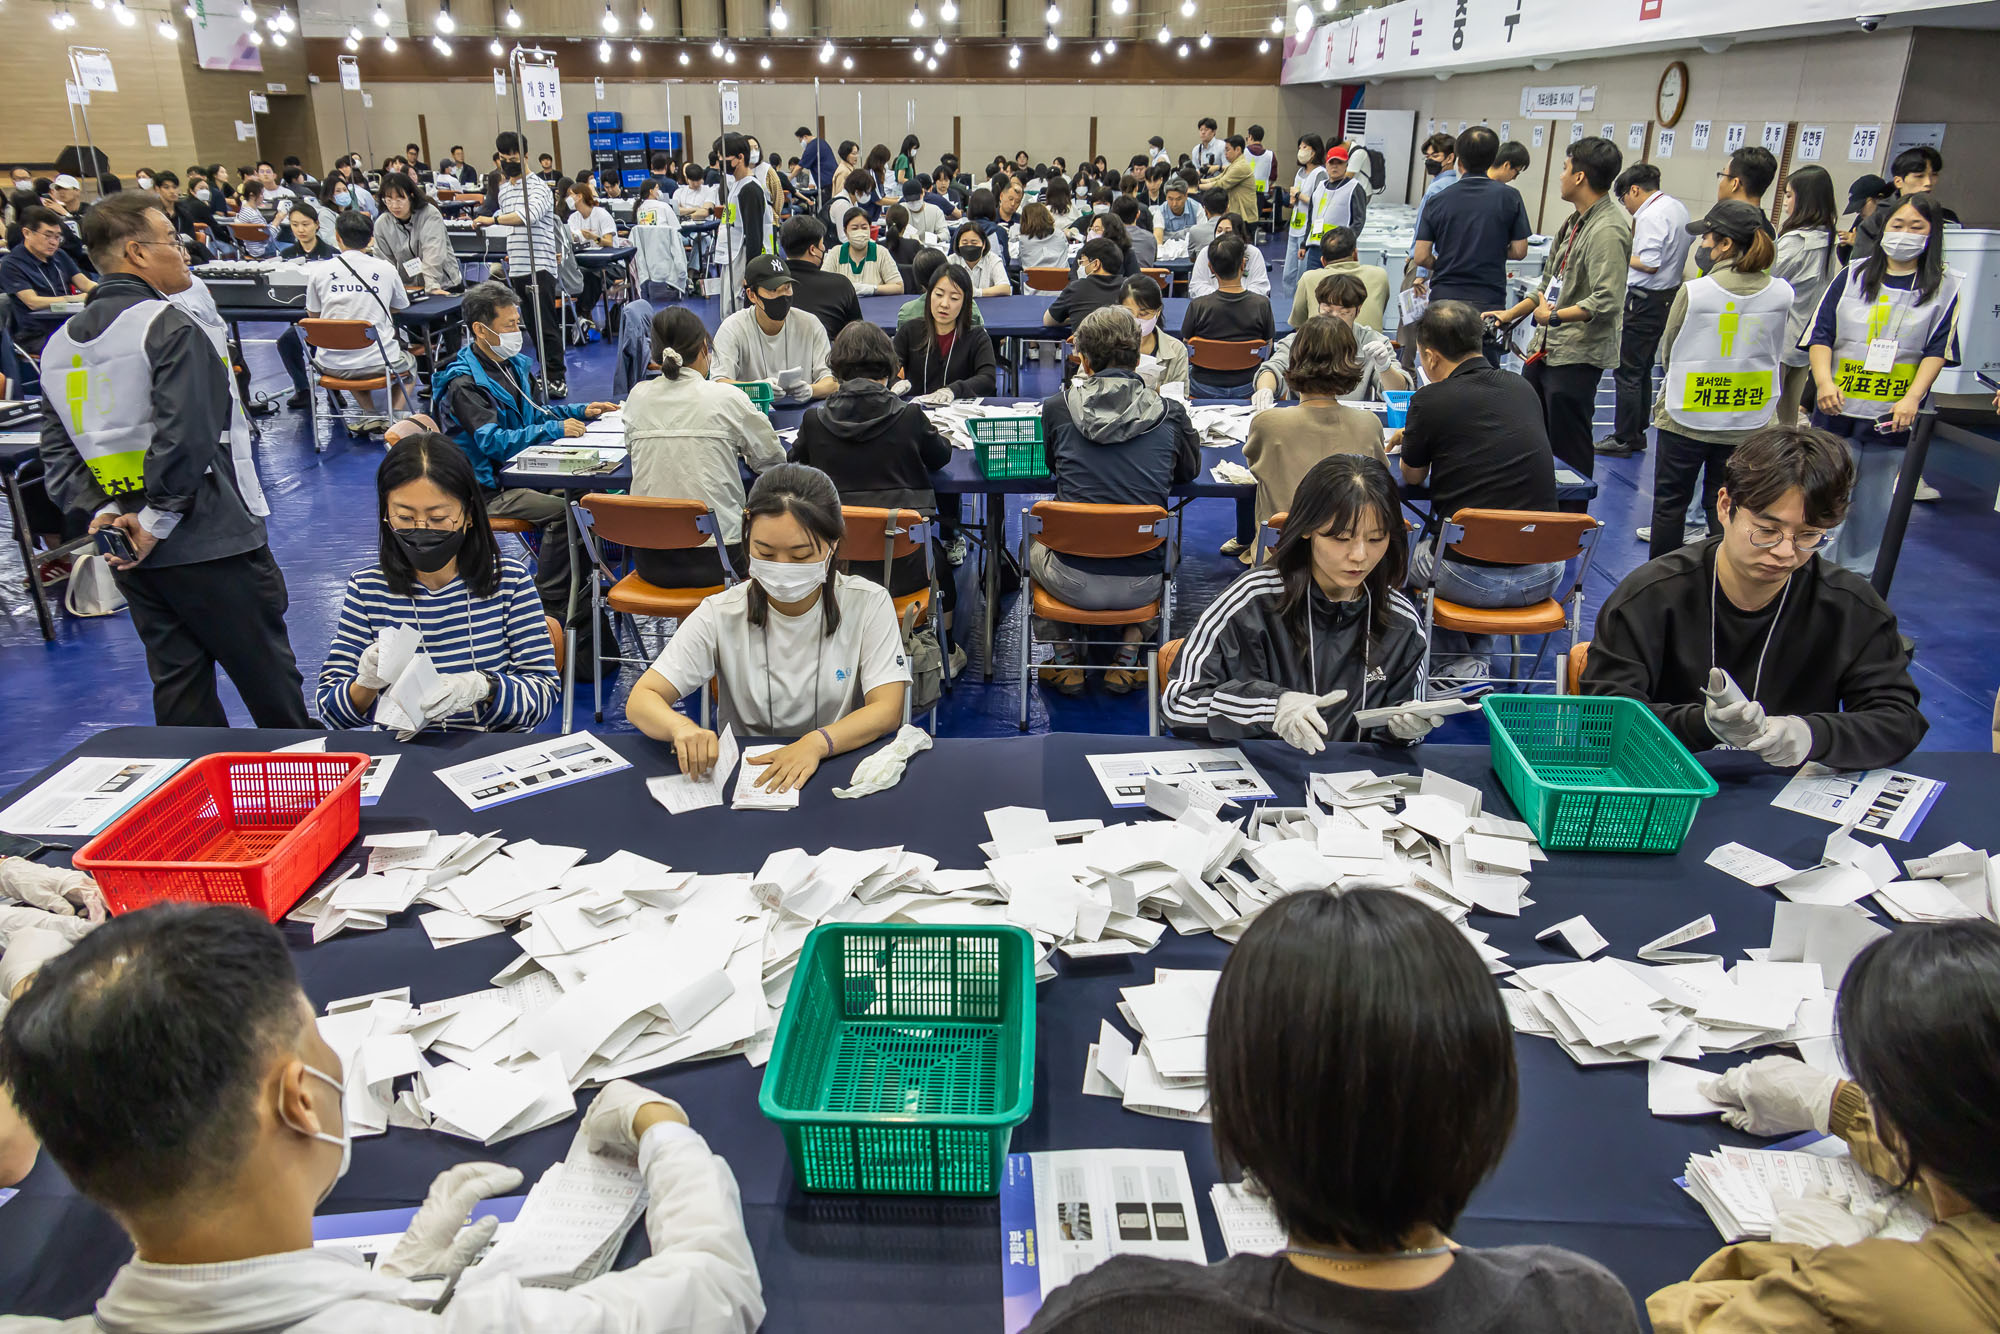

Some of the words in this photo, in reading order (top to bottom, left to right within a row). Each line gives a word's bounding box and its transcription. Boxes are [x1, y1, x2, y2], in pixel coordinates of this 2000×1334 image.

[1765, 127, 1781, 141] 명동
[1802, 131, 1822, 147] 회현동
[1853, 130, 1876, 147] 소공동
[1856, 148, 1867, 158] (2)
[1695, 376, 1732, 387] 질서있는
[1839, 375, 1908, 396] 개표참관
[1693, 386, 1764, 407] 개표참관
